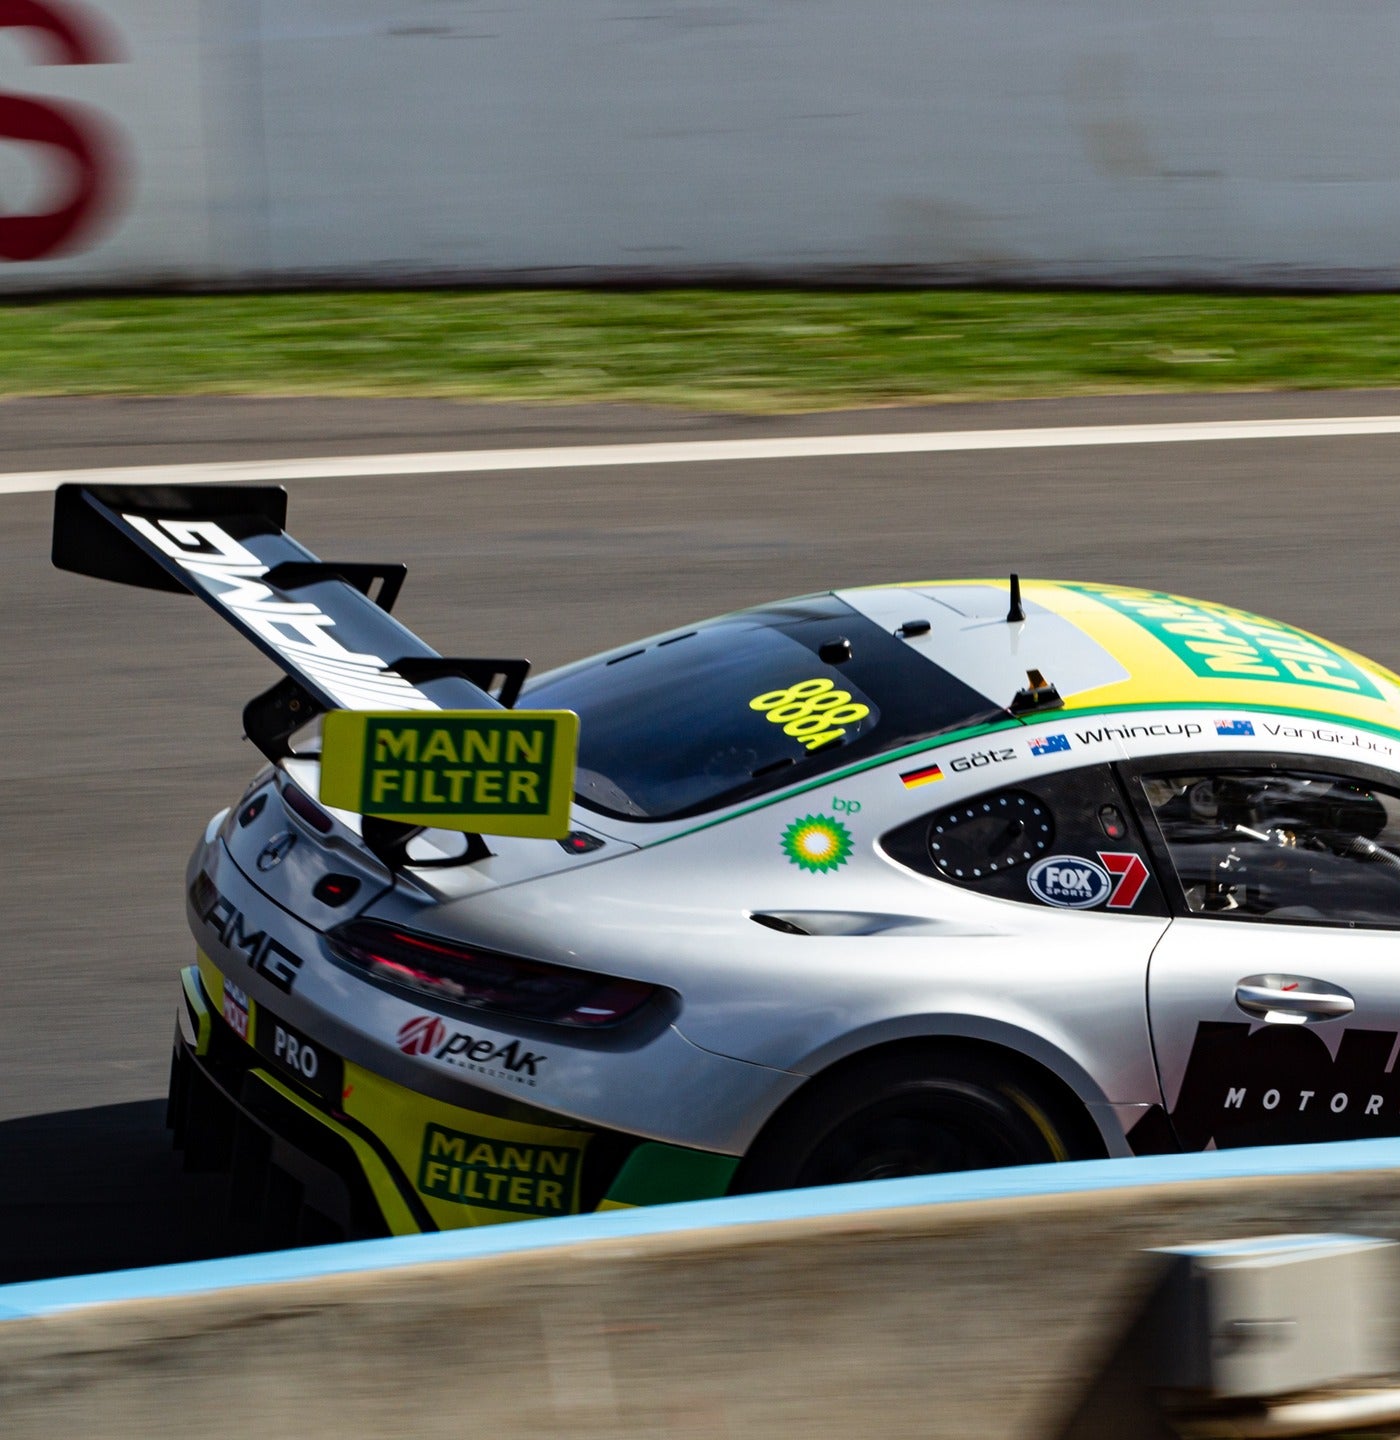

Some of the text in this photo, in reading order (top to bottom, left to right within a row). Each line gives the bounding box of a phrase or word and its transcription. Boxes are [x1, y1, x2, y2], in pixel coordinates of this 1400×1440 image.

[373, 728, 544, 764] MANN
[1075, 722, 1202, 745] Whincup
[950, 748, 1017, 773] Götz
[371, 768, 540, 804] FILTER
[832, 796, 861, 816] bp
[1045, 866, 1092, 892] FOX
[1045, 886, 1093, 898] SPORTS
[202, 896, 304, 995] AMG
[274, 1025, 318, 1078] PRO
[429, 1131, 569, 1176] MANN
[424, 1160, 563, 1209] FILTER
